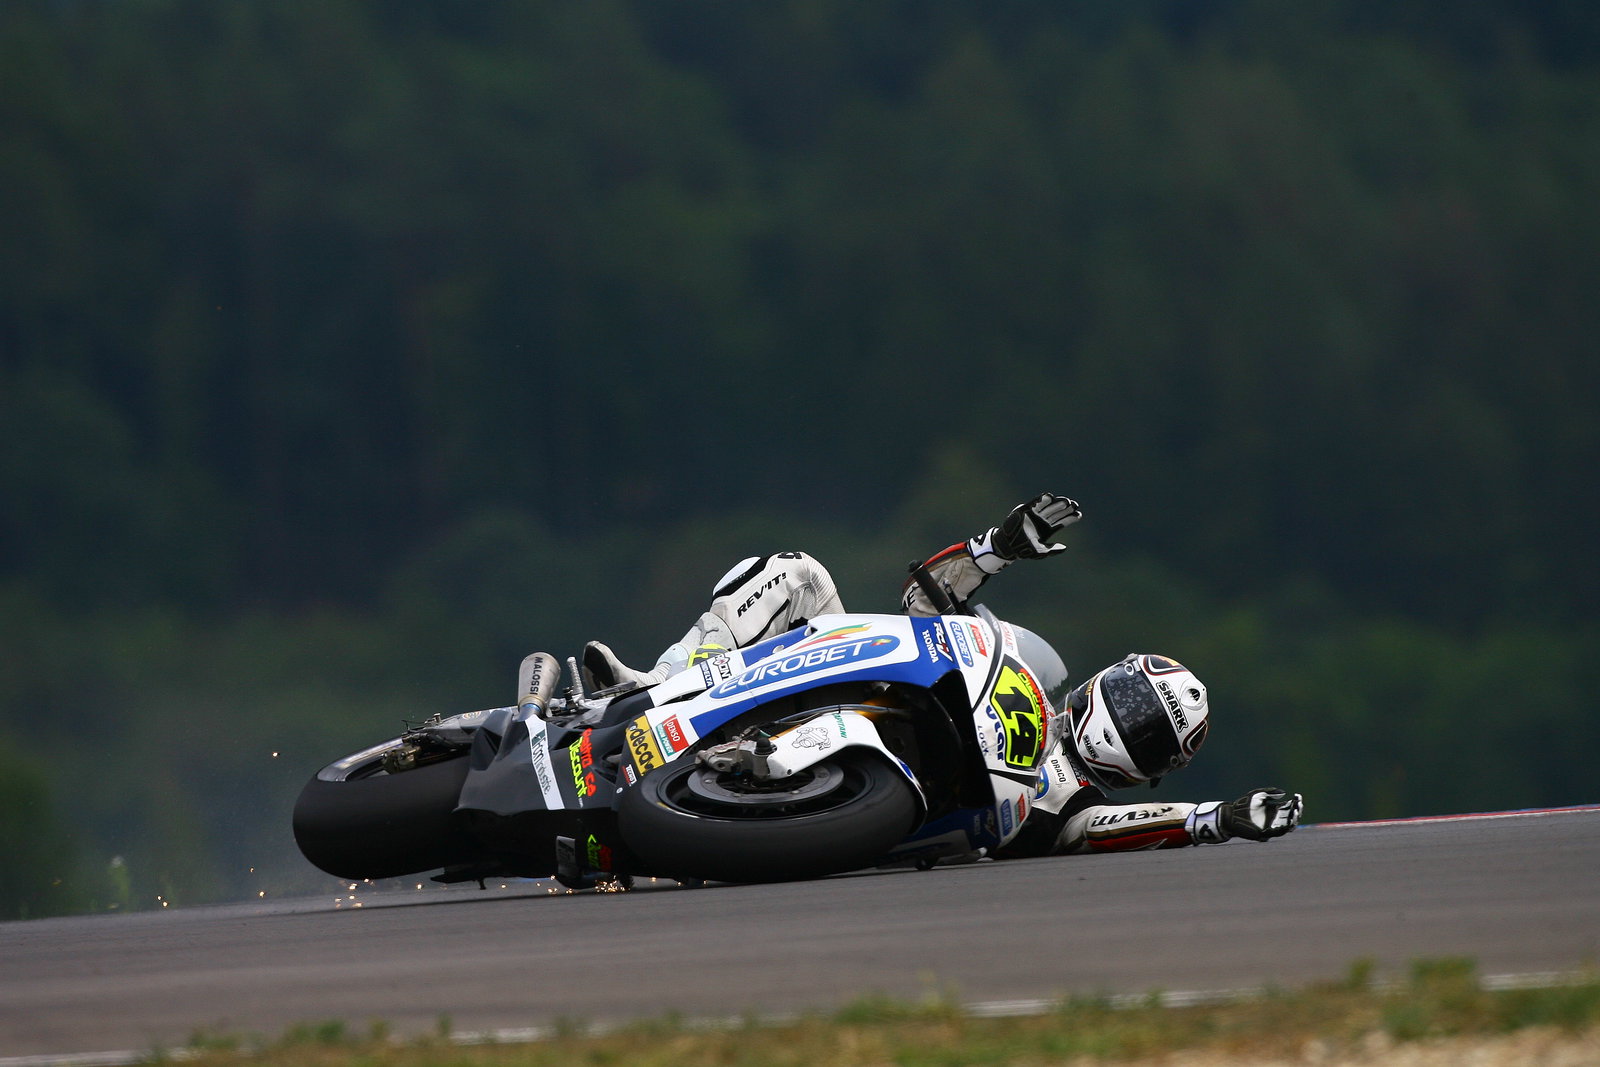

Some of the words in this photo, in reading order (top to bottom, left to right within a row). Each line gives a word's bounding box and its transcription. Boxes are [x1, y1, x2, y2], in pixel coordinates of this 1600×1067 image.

[737, 572, 787, 617] REV'IT!
[922, 630, 939, 663] HONDA
[953, 624, 970, 659] EUROBET
[529, 657, 542, 695] MALOSSI
[719, 639, 874, 693] EUROBET
[1157, 681, 1188, 732] SHARK
[667, 721, 681, 742] DENSO
[994, 686, 1037, 764] 14
[1082, 734, 1099, 759] SHARK
[1051, 759, 1067, 783] DRACO
